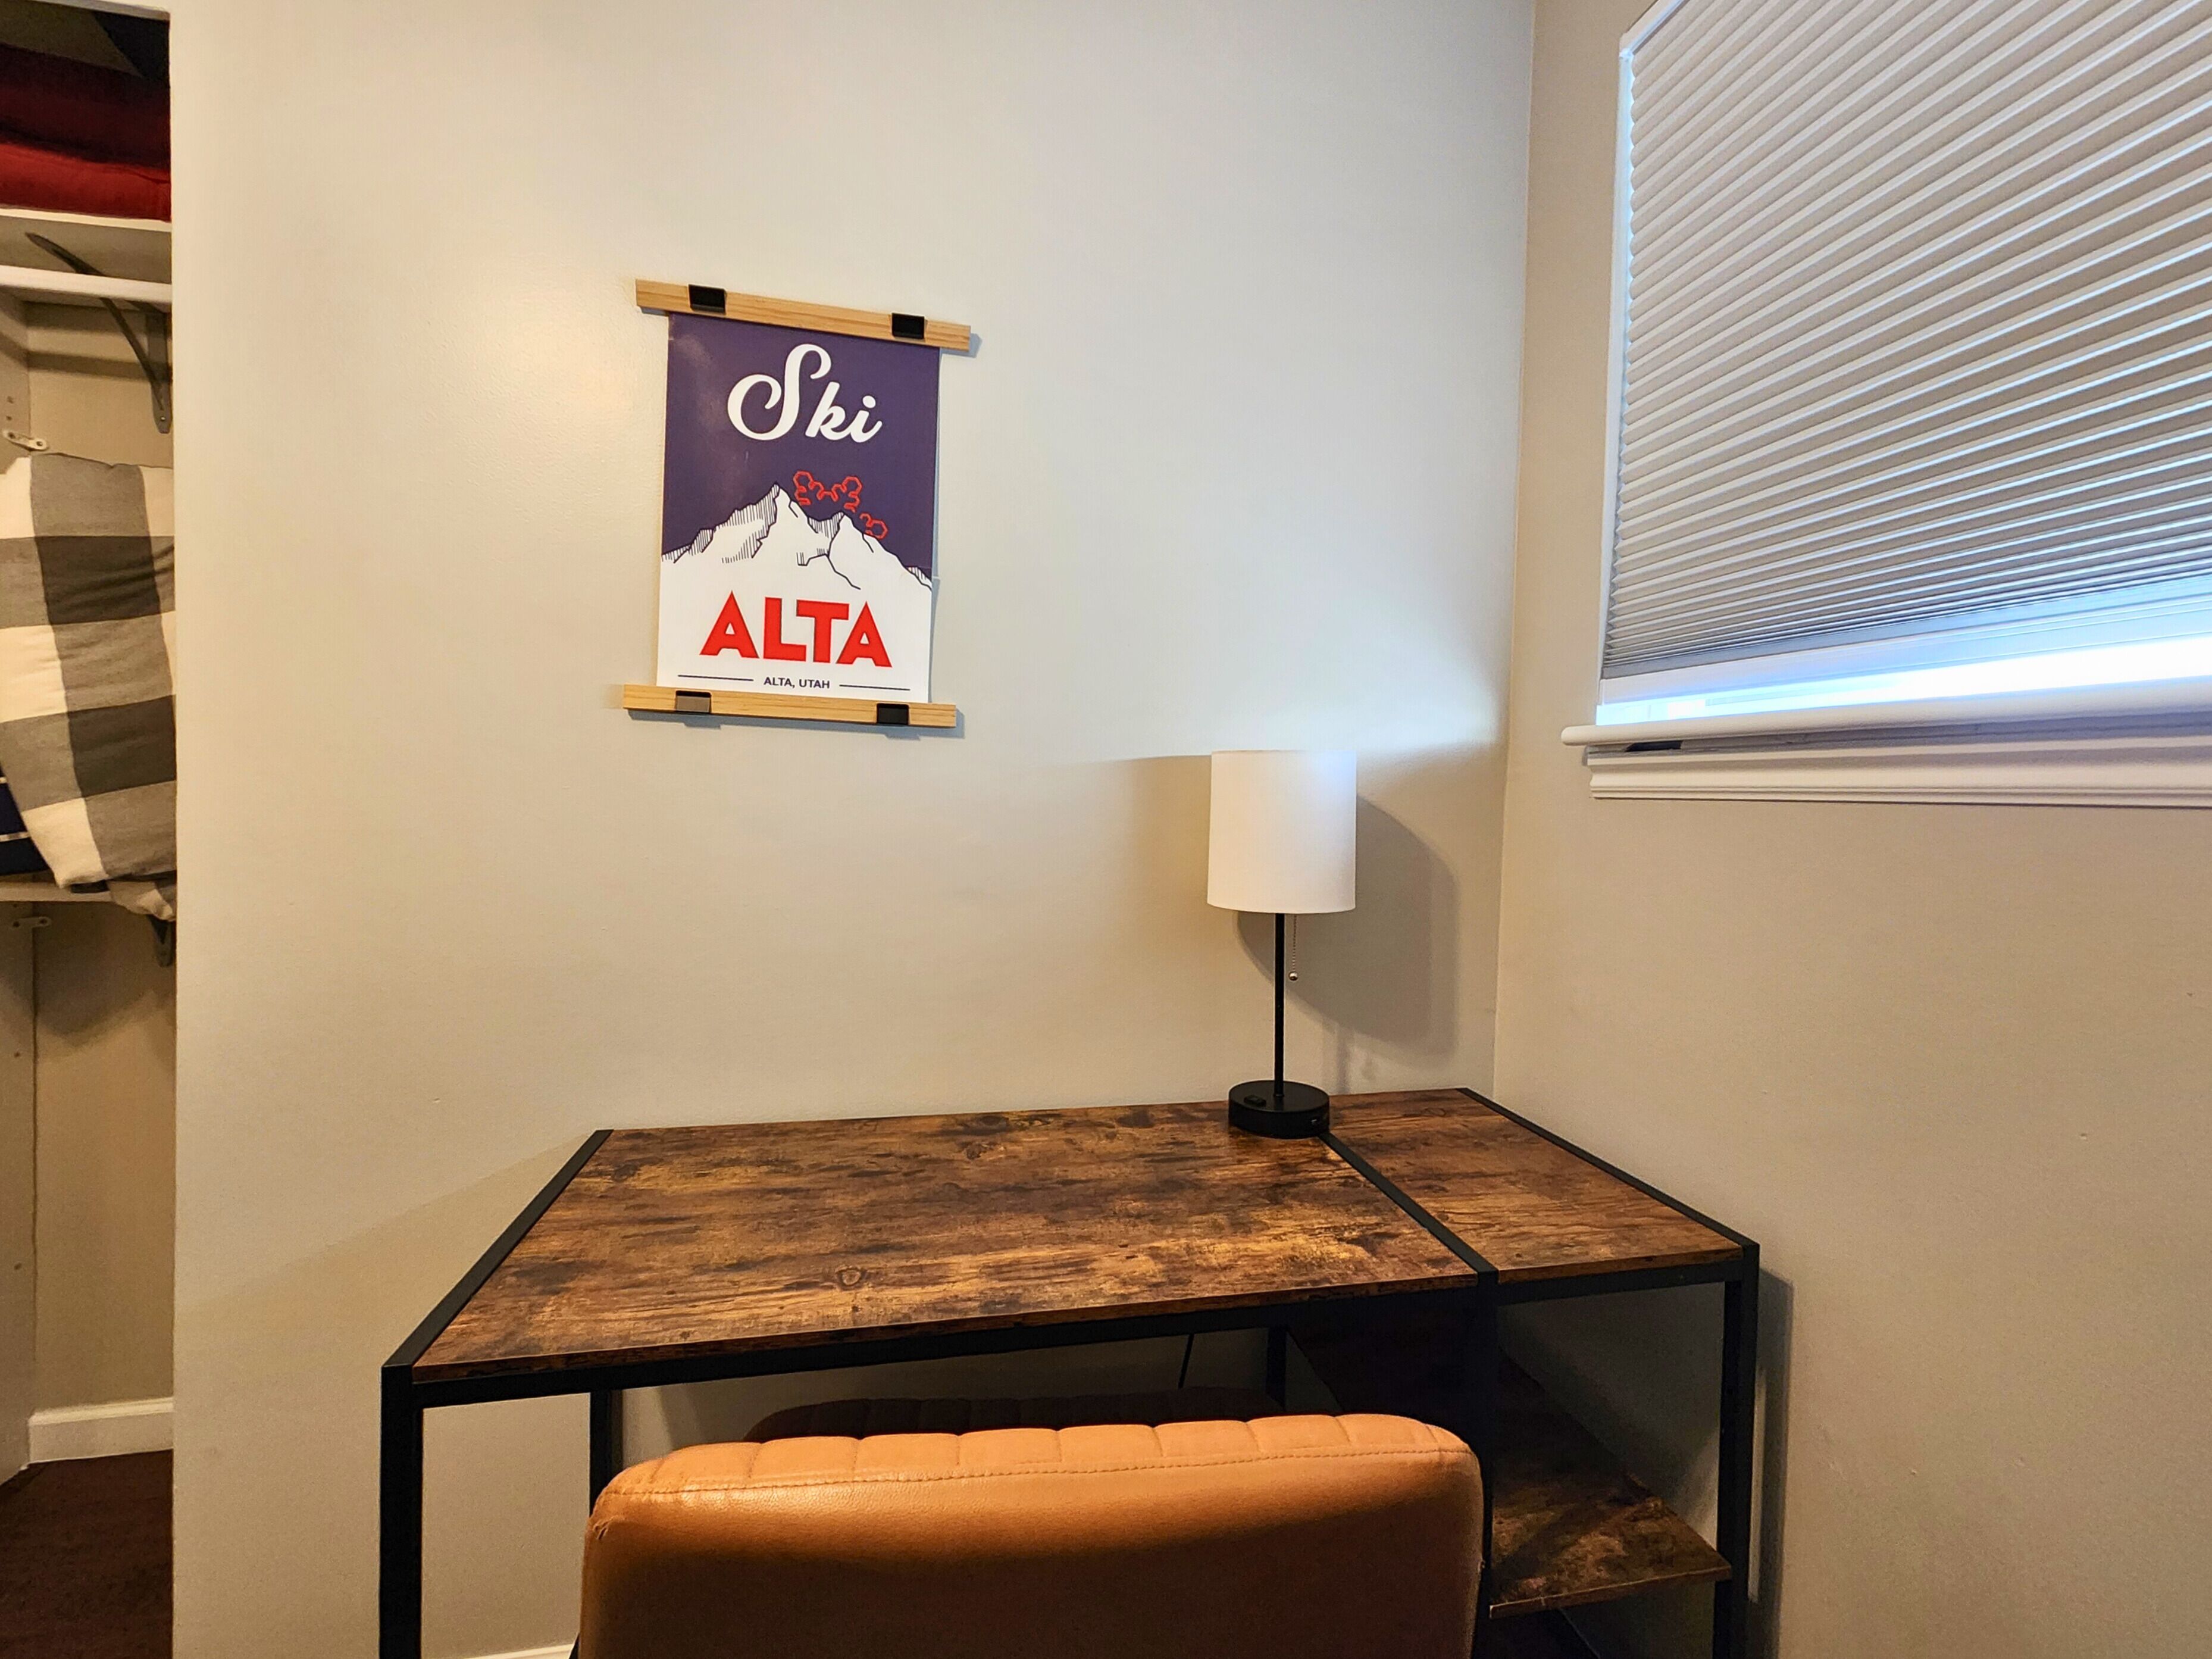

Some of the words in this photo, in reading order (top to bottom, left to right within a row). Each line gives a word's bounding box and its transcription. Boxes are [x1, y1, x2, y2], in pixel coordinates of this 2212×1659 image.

[727, 343, 883, 443] Ski
[699, 590, 893, 668] ALTA
[764, 676, 796, 689] ALTA,
[799, 678, 830, 689] UTAH
